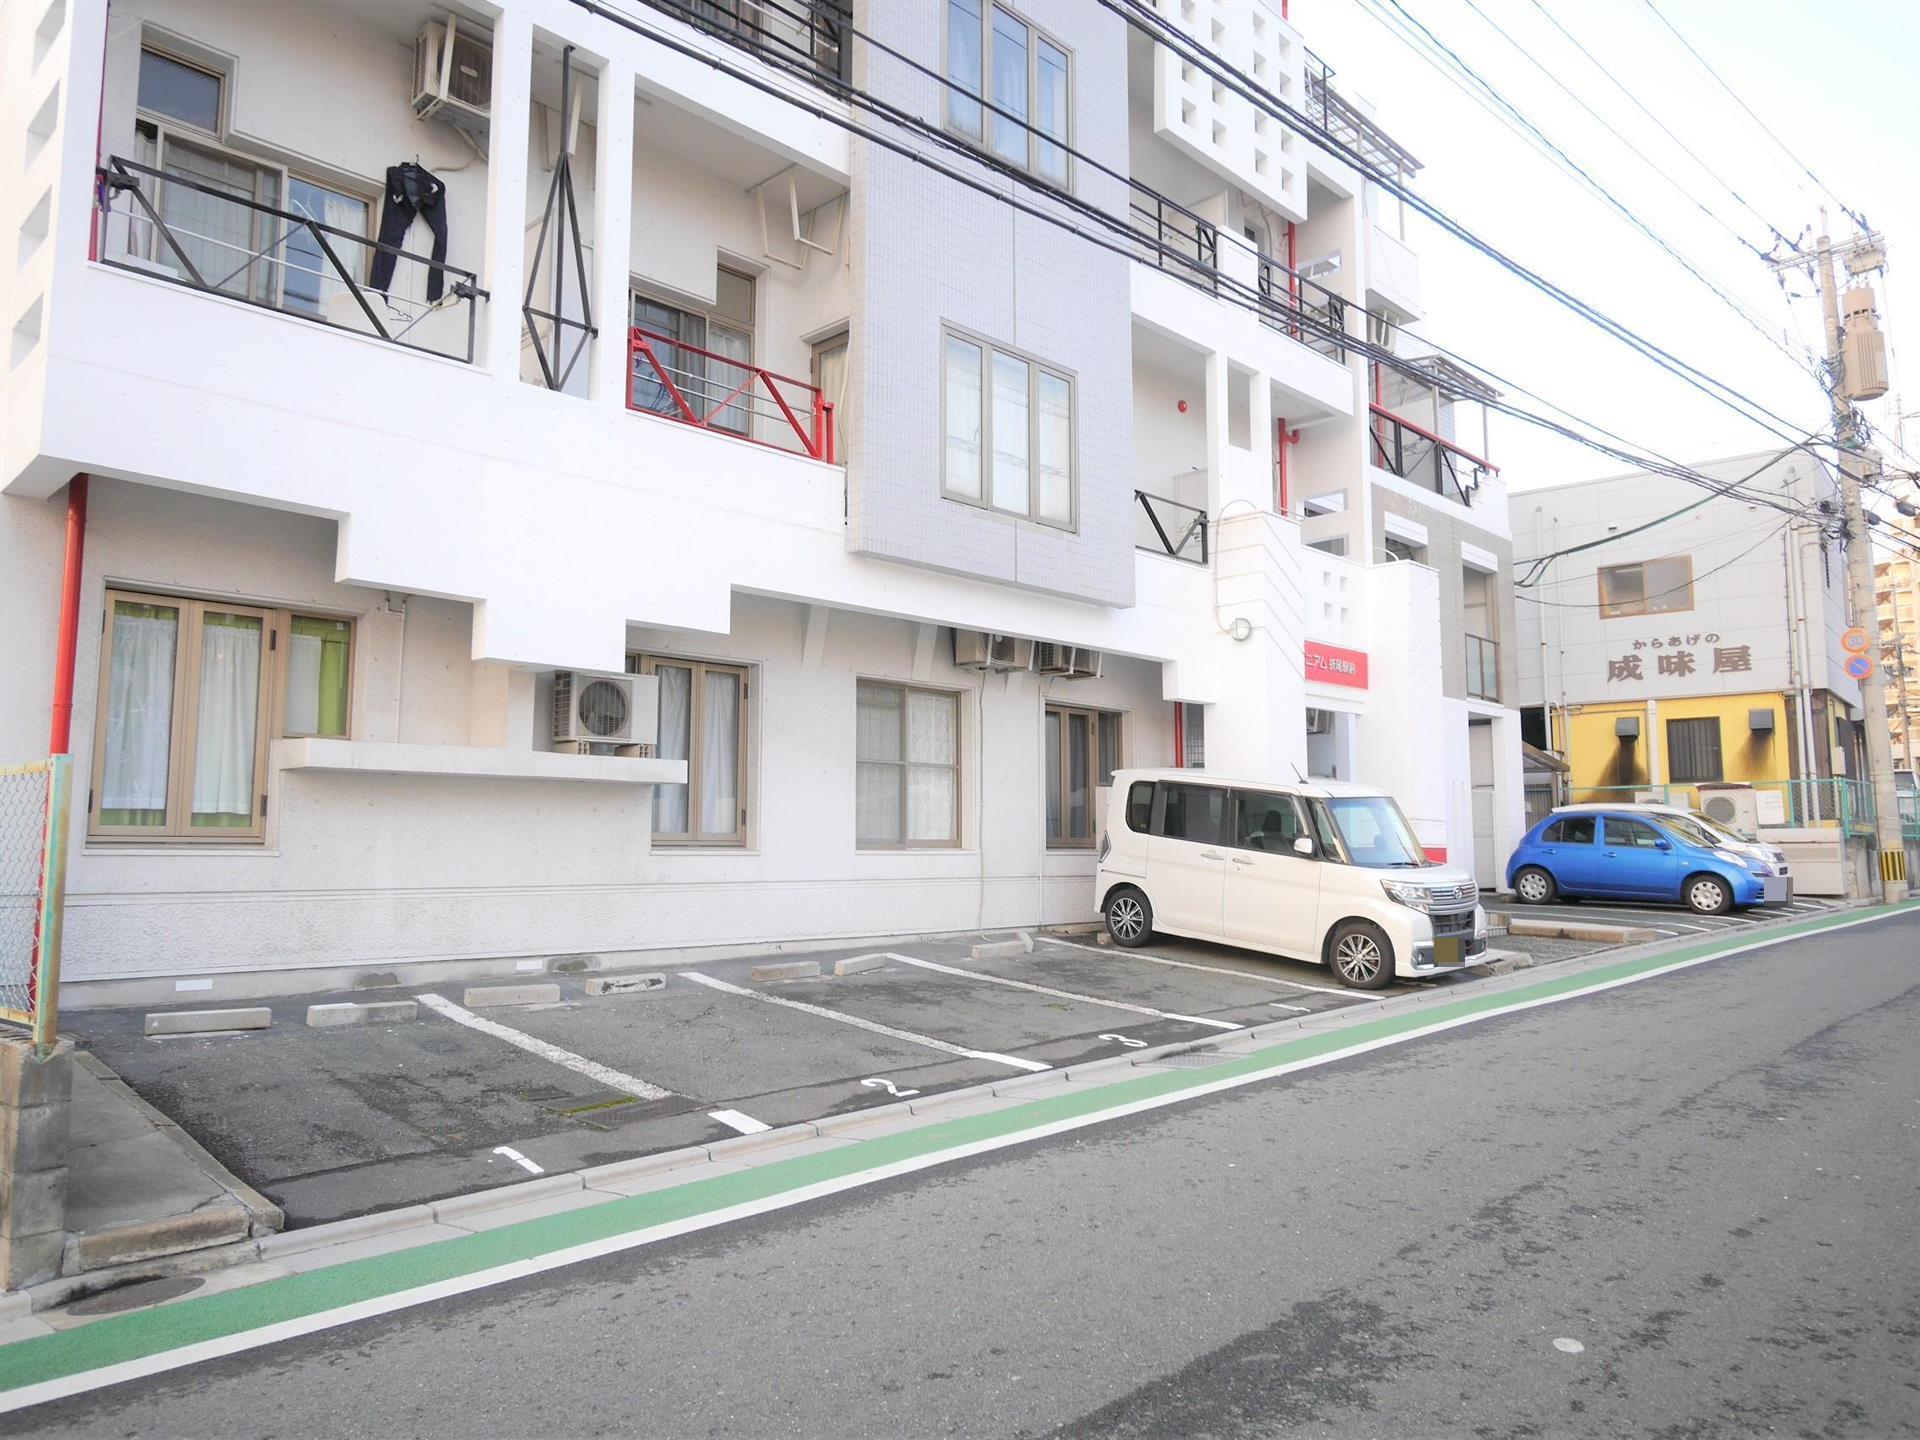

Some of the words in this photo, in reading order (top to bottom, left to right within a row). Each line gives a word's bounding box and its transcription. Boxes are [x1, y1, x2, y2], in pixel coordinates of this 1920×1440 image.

[1632, 633, 1720, 650] からあげの
[1607, 645, 1752, 682] 成味屋
[1098, 1034, 1148, 1047] 3
[860, 1078, 920, 1097] 2
